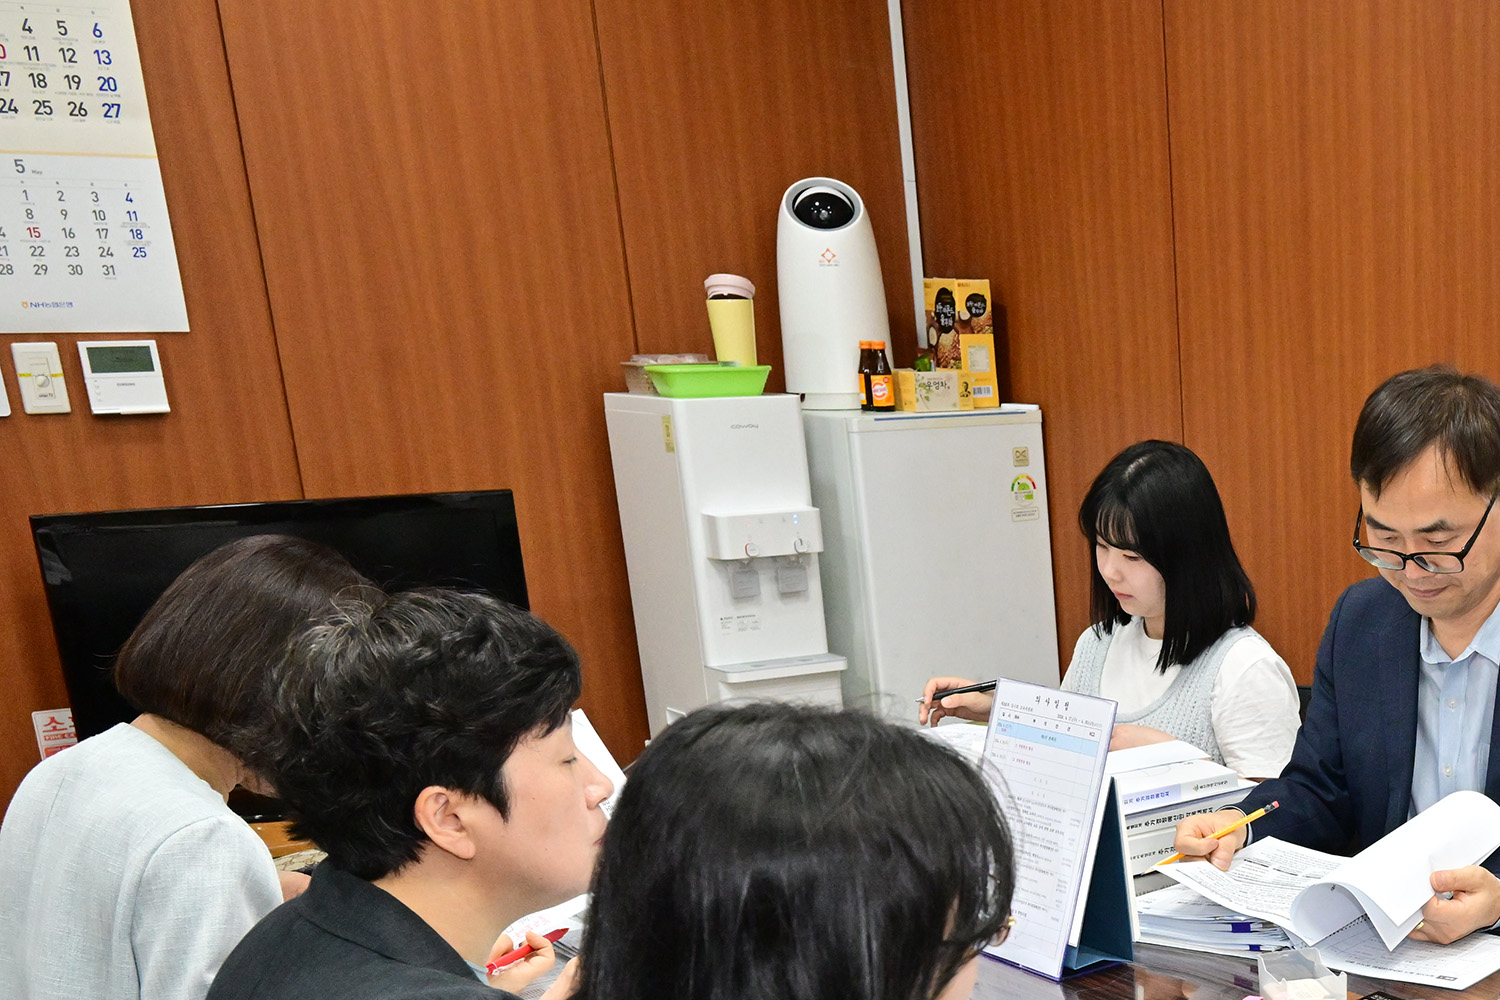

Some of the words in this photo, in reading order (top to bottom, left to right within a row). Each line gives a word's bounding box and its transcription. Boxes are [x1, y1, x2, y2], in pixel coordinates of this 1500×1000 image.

[22, 18, 33, 34] 4
[56, 20, 68, 36] 5
[92, 22, 103, 38] 6
[23, 45, 40, 62] 11
[58, 47, 78, 64] 12
[93, 49, 112, 65] 13
[28, 72, 48, 89] 18
[64, 74, 82, 91] 19
[97, 76, 118, 92] 20
[32, 99, 53, 116] 25
[67, 101, 88, 117] 26
[102, 102, 121, 119] 27
[14, 159, 26, 174] 5
[22, 190, 29, 201] 1
[56, 190, 66, 202] 2
[91, 191, 100, 203] 3
[125, 192, 134, 204] 4
[25, 208, 34, 220] 8
[60, 209, 68, 220] 9
[92, 209, 106, 221] 10
[125, 210, 139, 222] 11
[26, 226, 41, 239] 15
[61, 227, 76, 239] 16
[95, 228, 109, 239] 17
[129, 228, 144, 240] 18
[29, 246, 46, 257] 22
[64, 246, 80, 257] 23
[98, 246, 114, 258] 24
[132, 247, 147, 258] 25
[33, 264, 49, 276] 29
[67, 264, 84, 276] 30
[102, 265, 116, 276] 31
[926, 381, 948, 390] 우엉차
